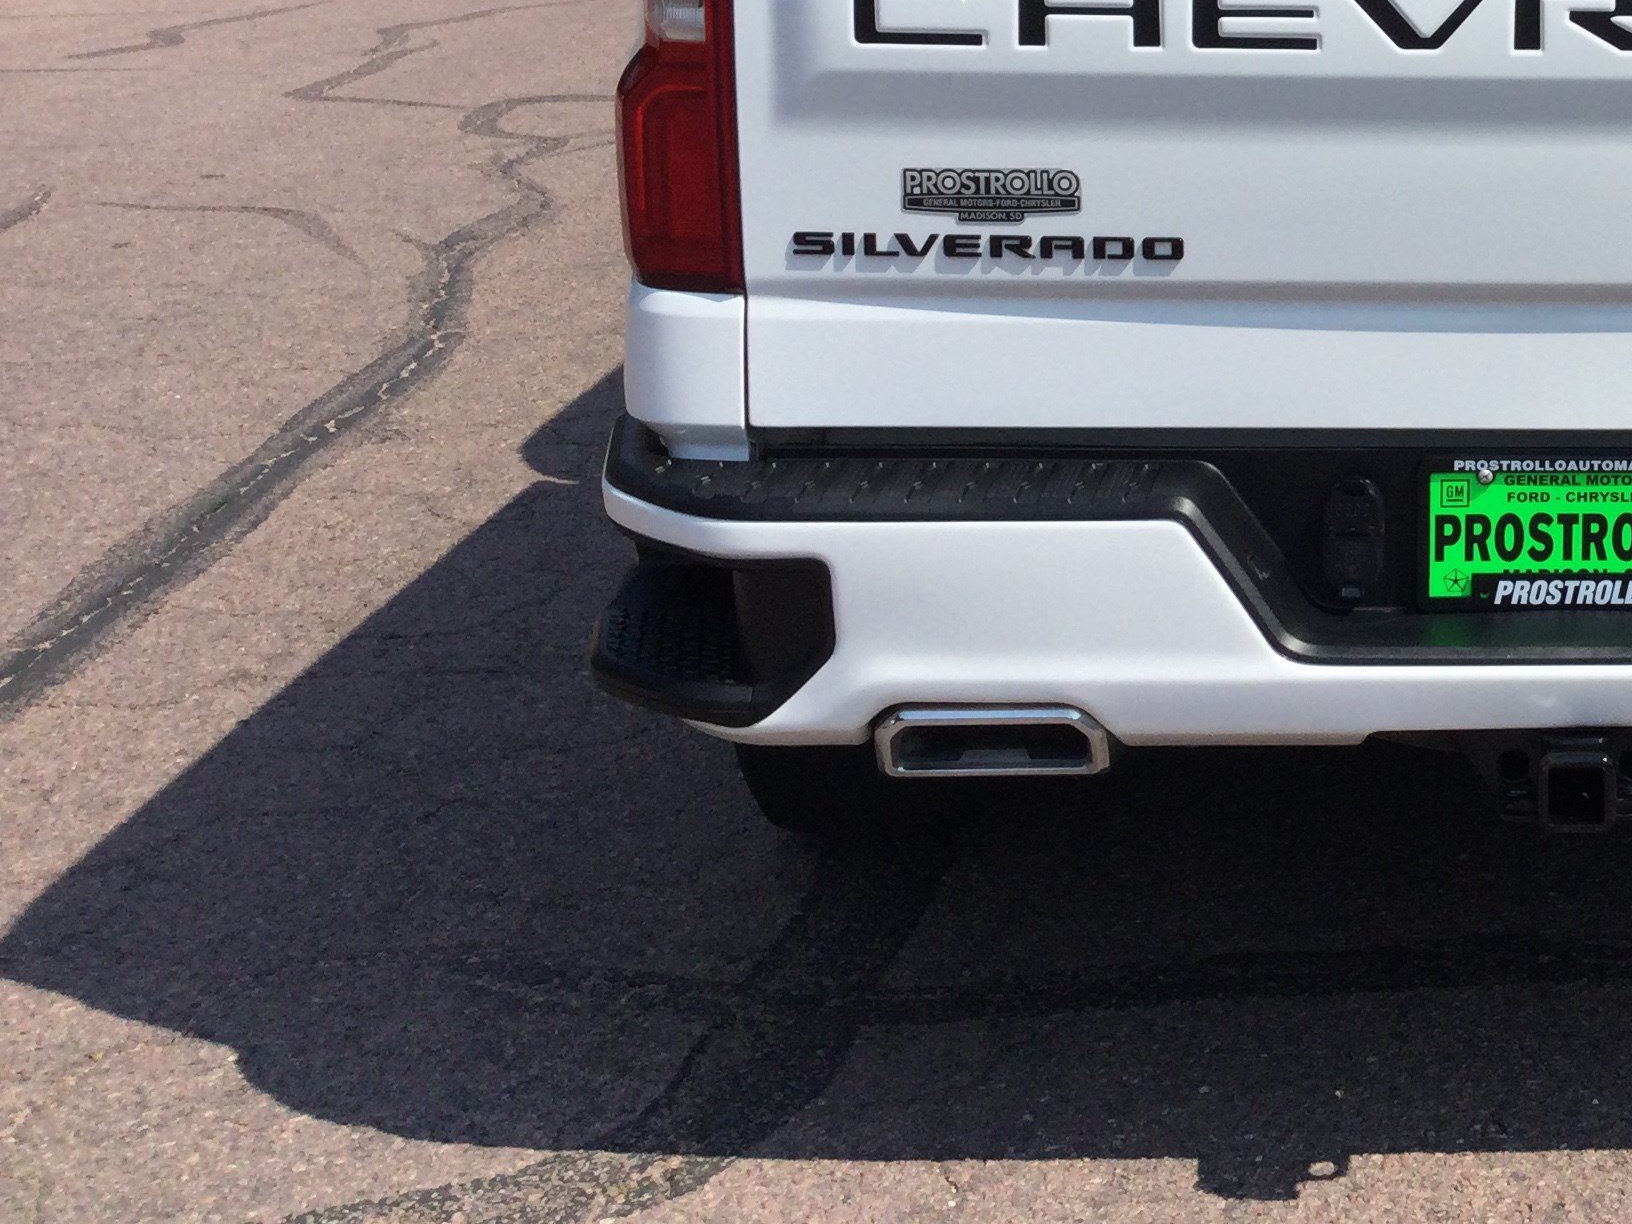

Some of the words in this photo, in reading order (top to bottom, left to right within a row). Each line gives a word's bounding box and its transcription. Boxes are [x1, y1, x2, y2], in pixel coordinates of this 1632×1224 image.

[905, 170, 1079, 196] PROSTROLLO
[922, 198, 958, 207] GENERAL
[1010, 212, 1023, 221] SD
[792, 232, 1185, 260] SILVERADO
[1504, 474, 1581, 487] GENERAL
[1445, 485, 1465, 499] GM
[1507, 491, 1551, 503] FORD
